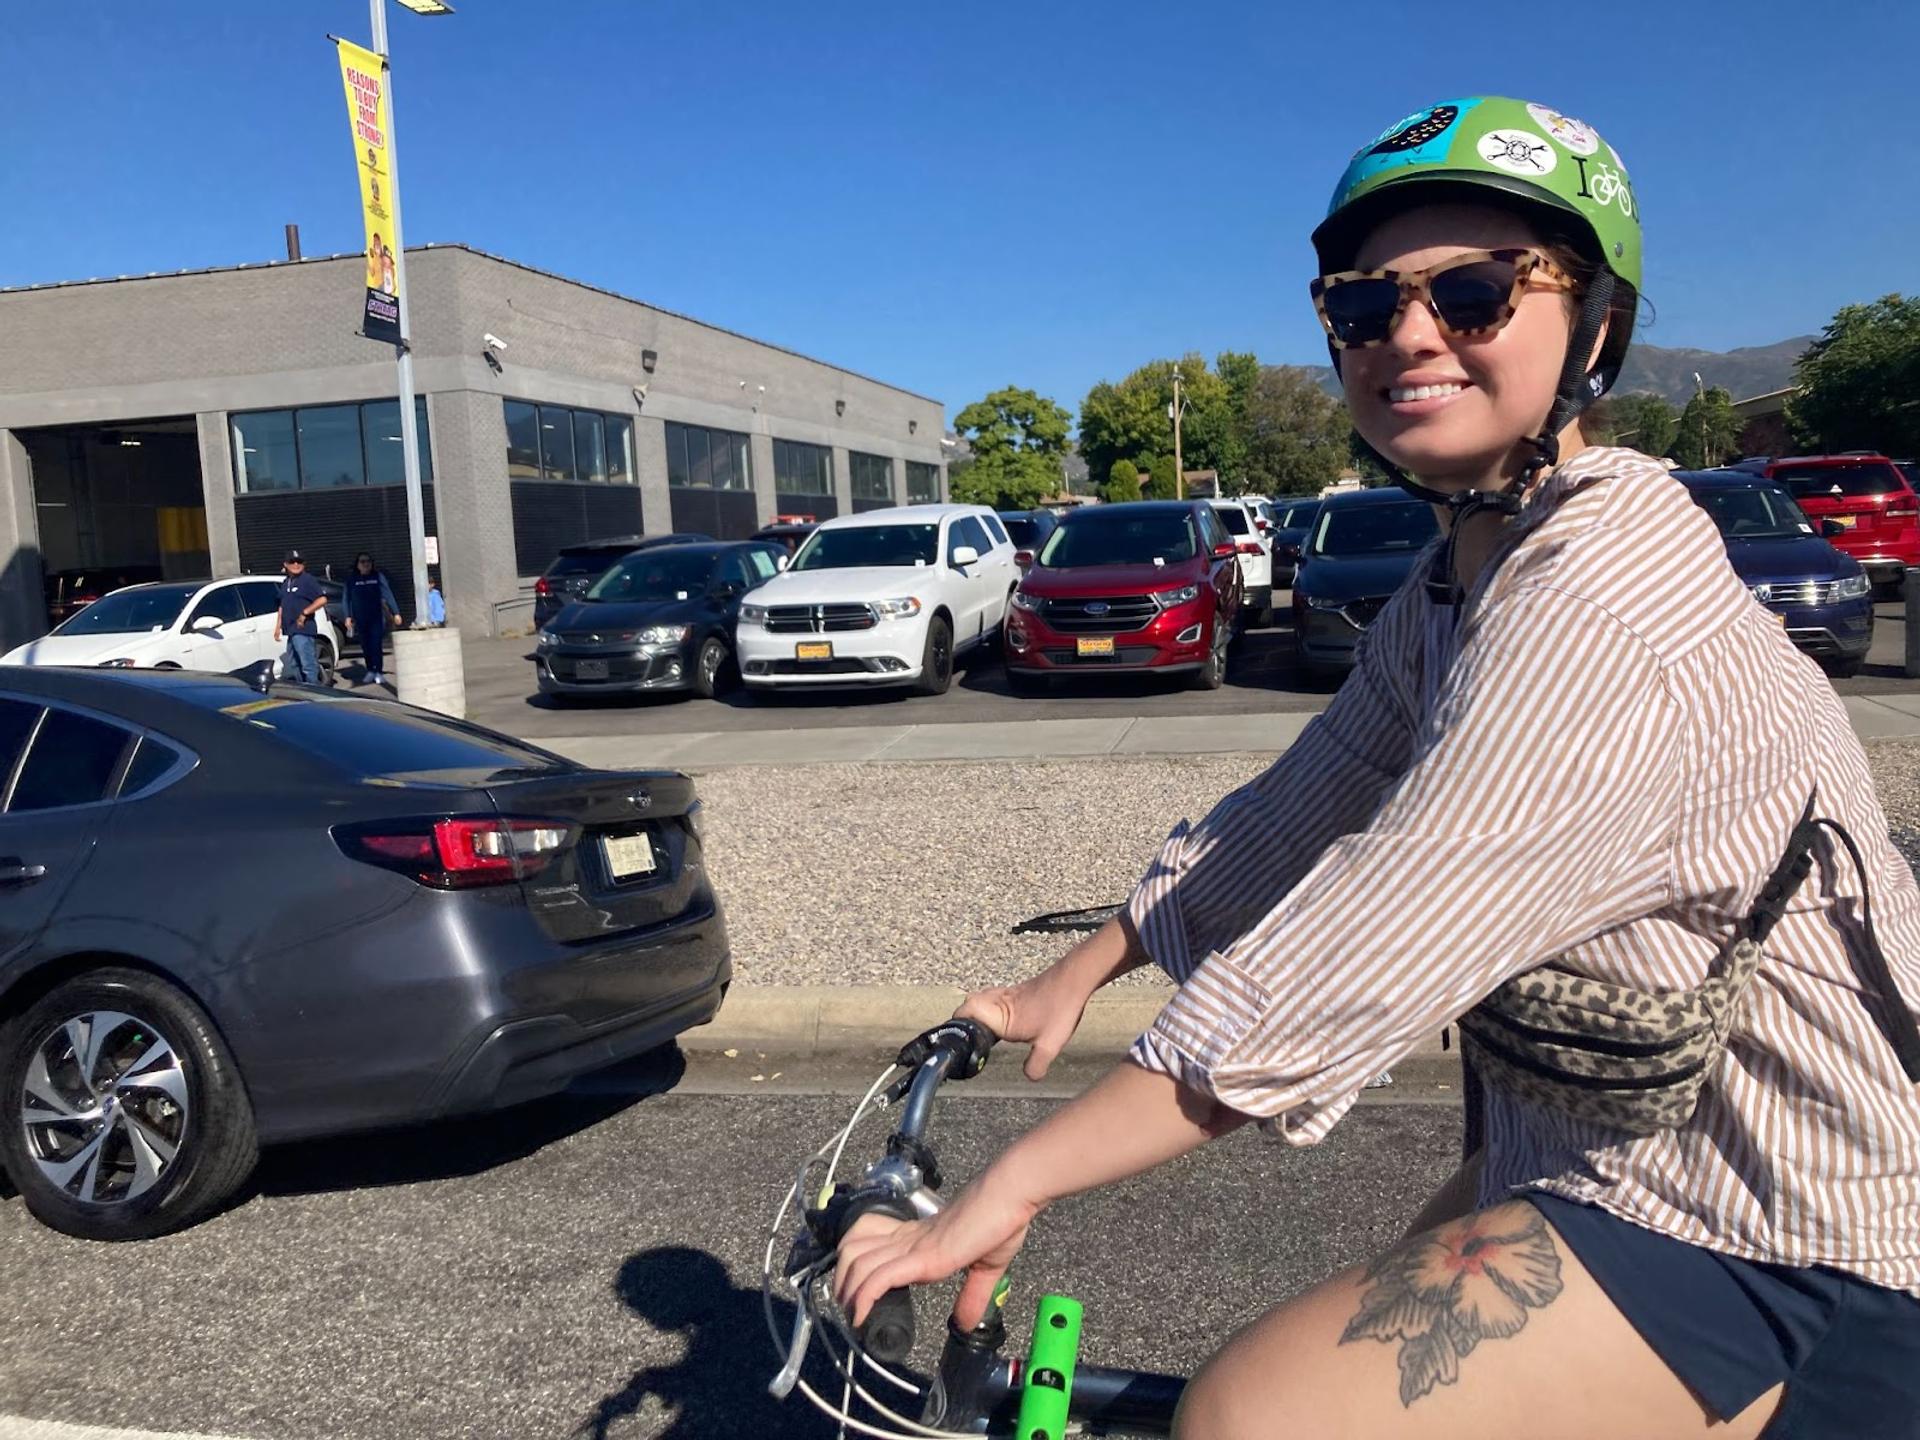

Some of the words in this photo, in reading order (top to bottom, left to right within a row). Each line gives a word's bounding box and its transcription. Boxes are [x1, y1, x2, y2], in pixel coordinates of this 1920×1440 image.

[346, 67, 379, 95] REASONS
[354, 86, 363, 104] TO
[358, 105, 376, 127] FROM
